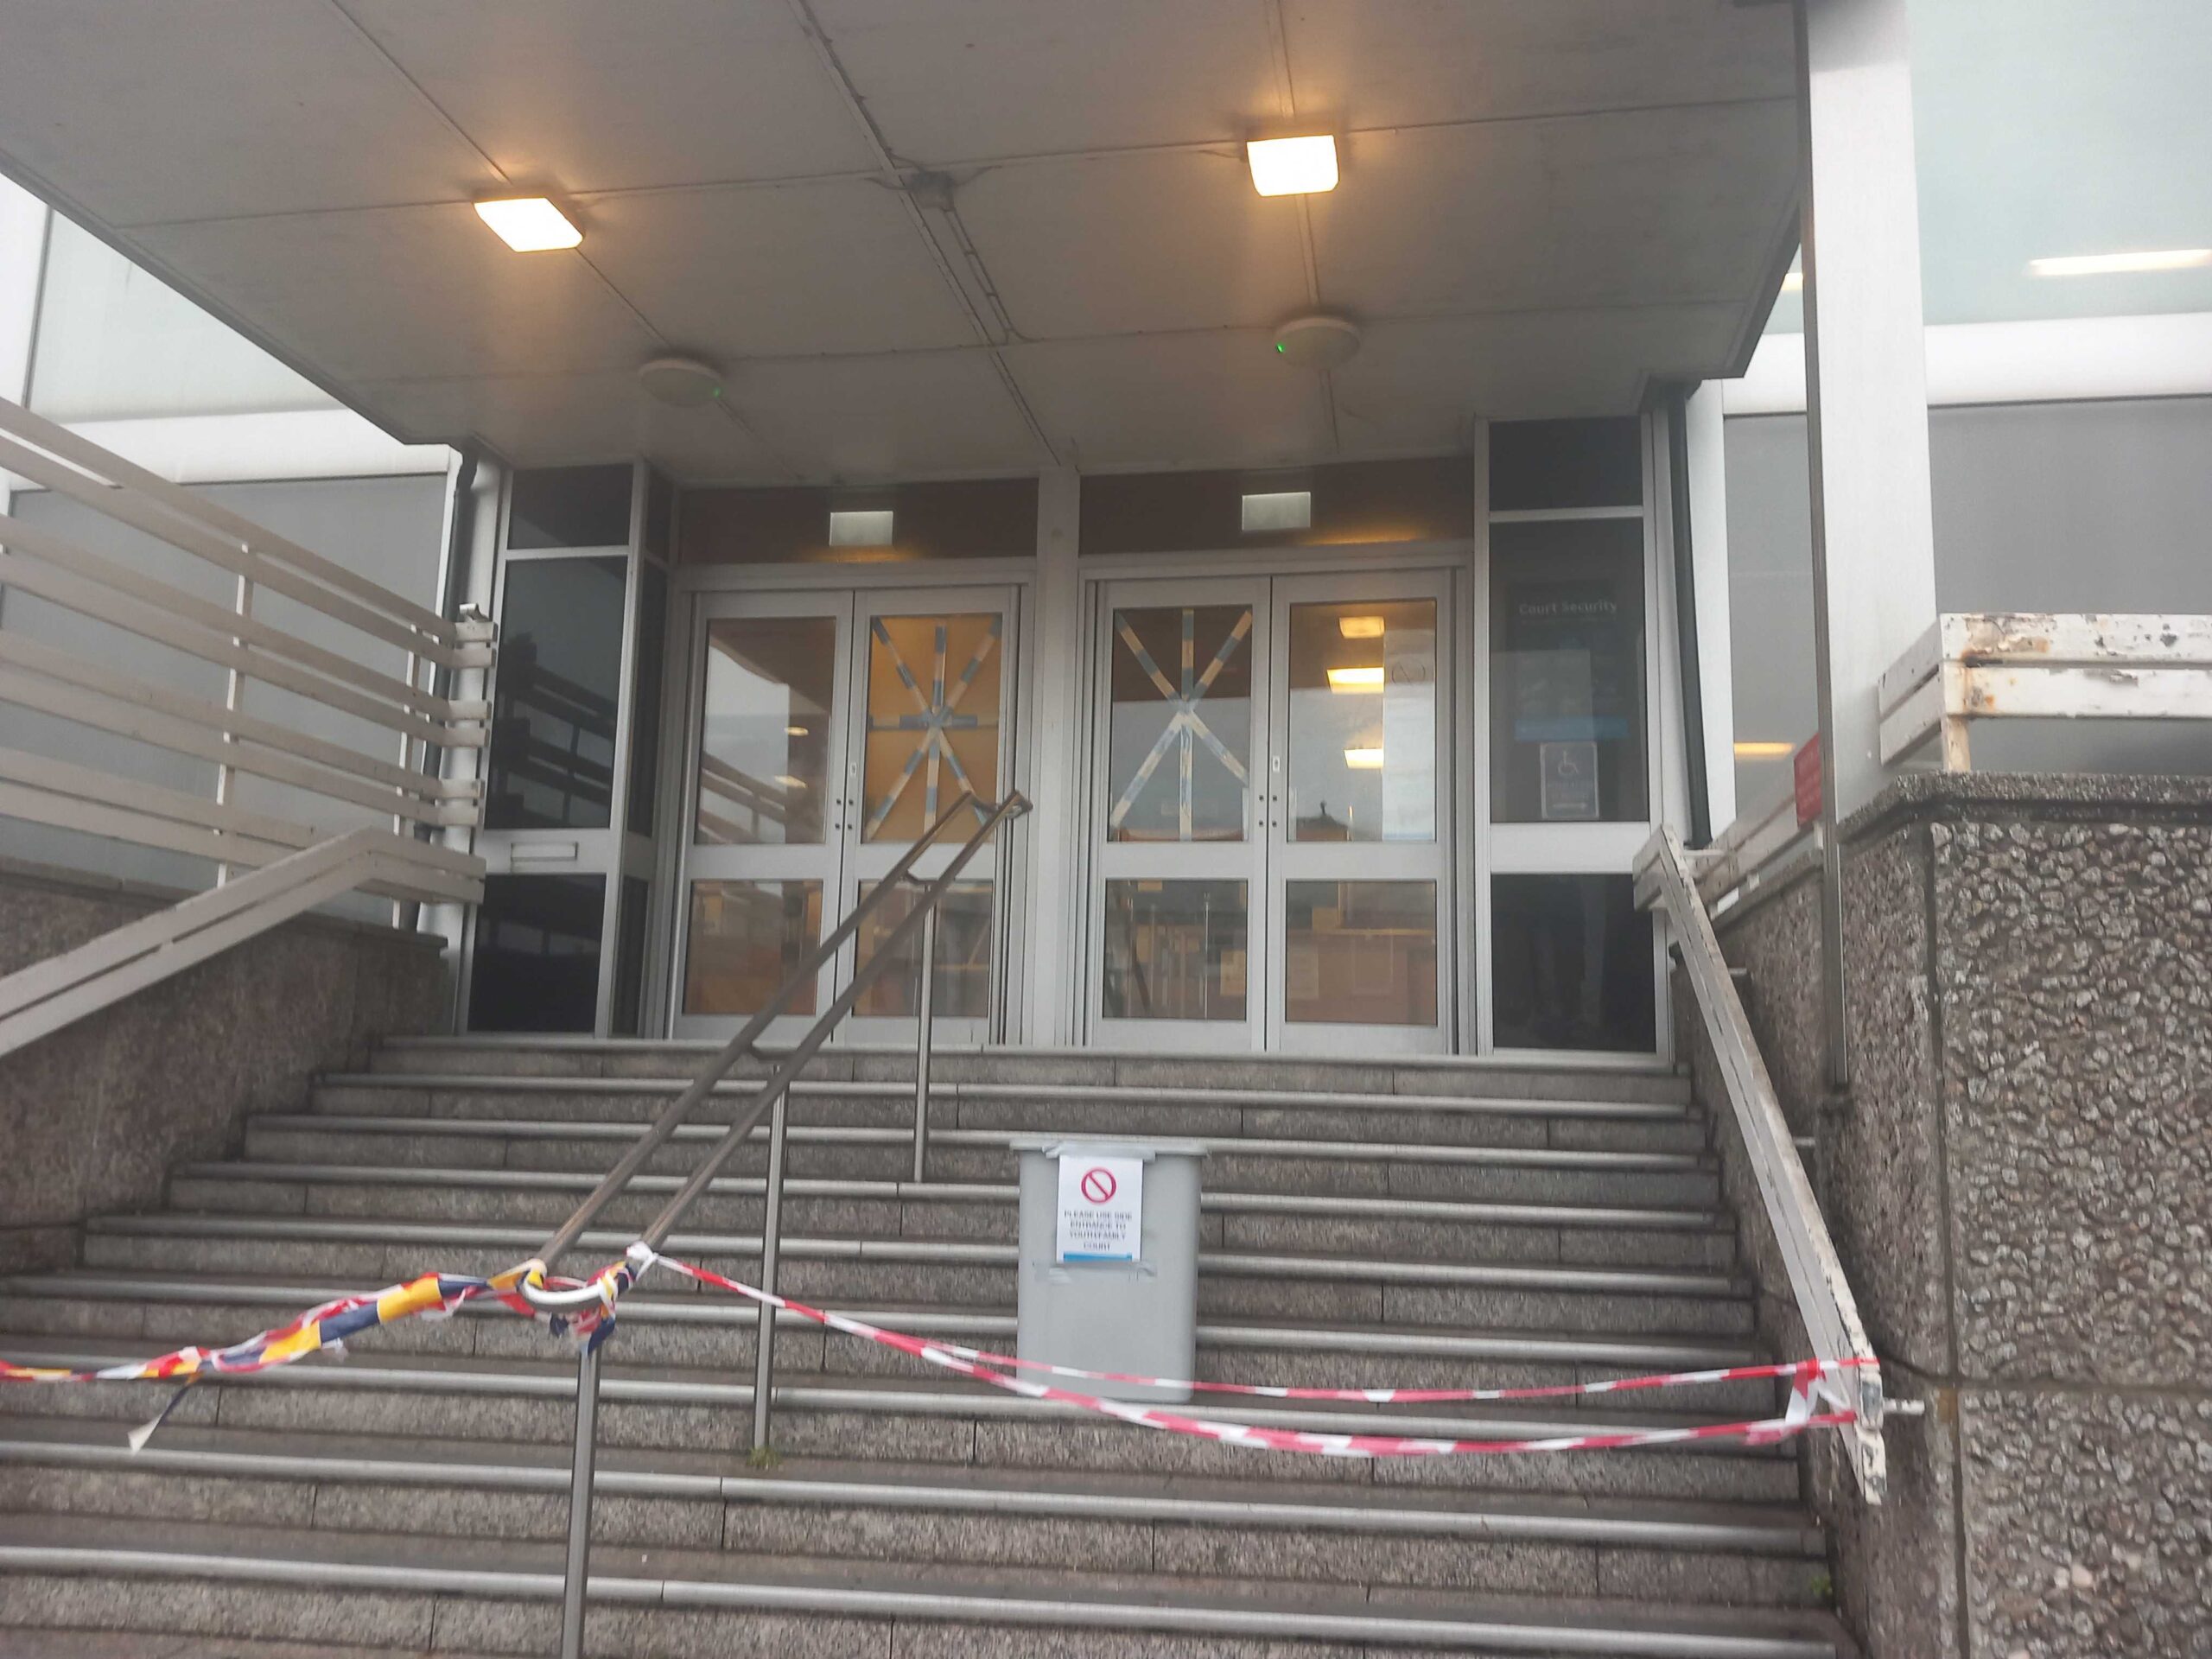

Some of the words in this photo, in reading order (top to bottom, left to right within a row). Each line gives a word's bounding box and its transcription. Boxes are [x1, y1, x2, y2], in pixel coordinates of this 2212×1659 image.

[1519, 603, 1557, 615] Court
[1562, 599, 1618, 614] Security
[1064, 1210, 1094, 1219] PLEASE
[1096, 1211, 1112, 1219] USE
[1115, 1211, 1133, 1221] SIDE
[1070, 1220, 1112, 1230] ENTRANCE
[1116, 1222, 1127, 1230] TO
[1084, 1242, 1111, 1251] COURT
